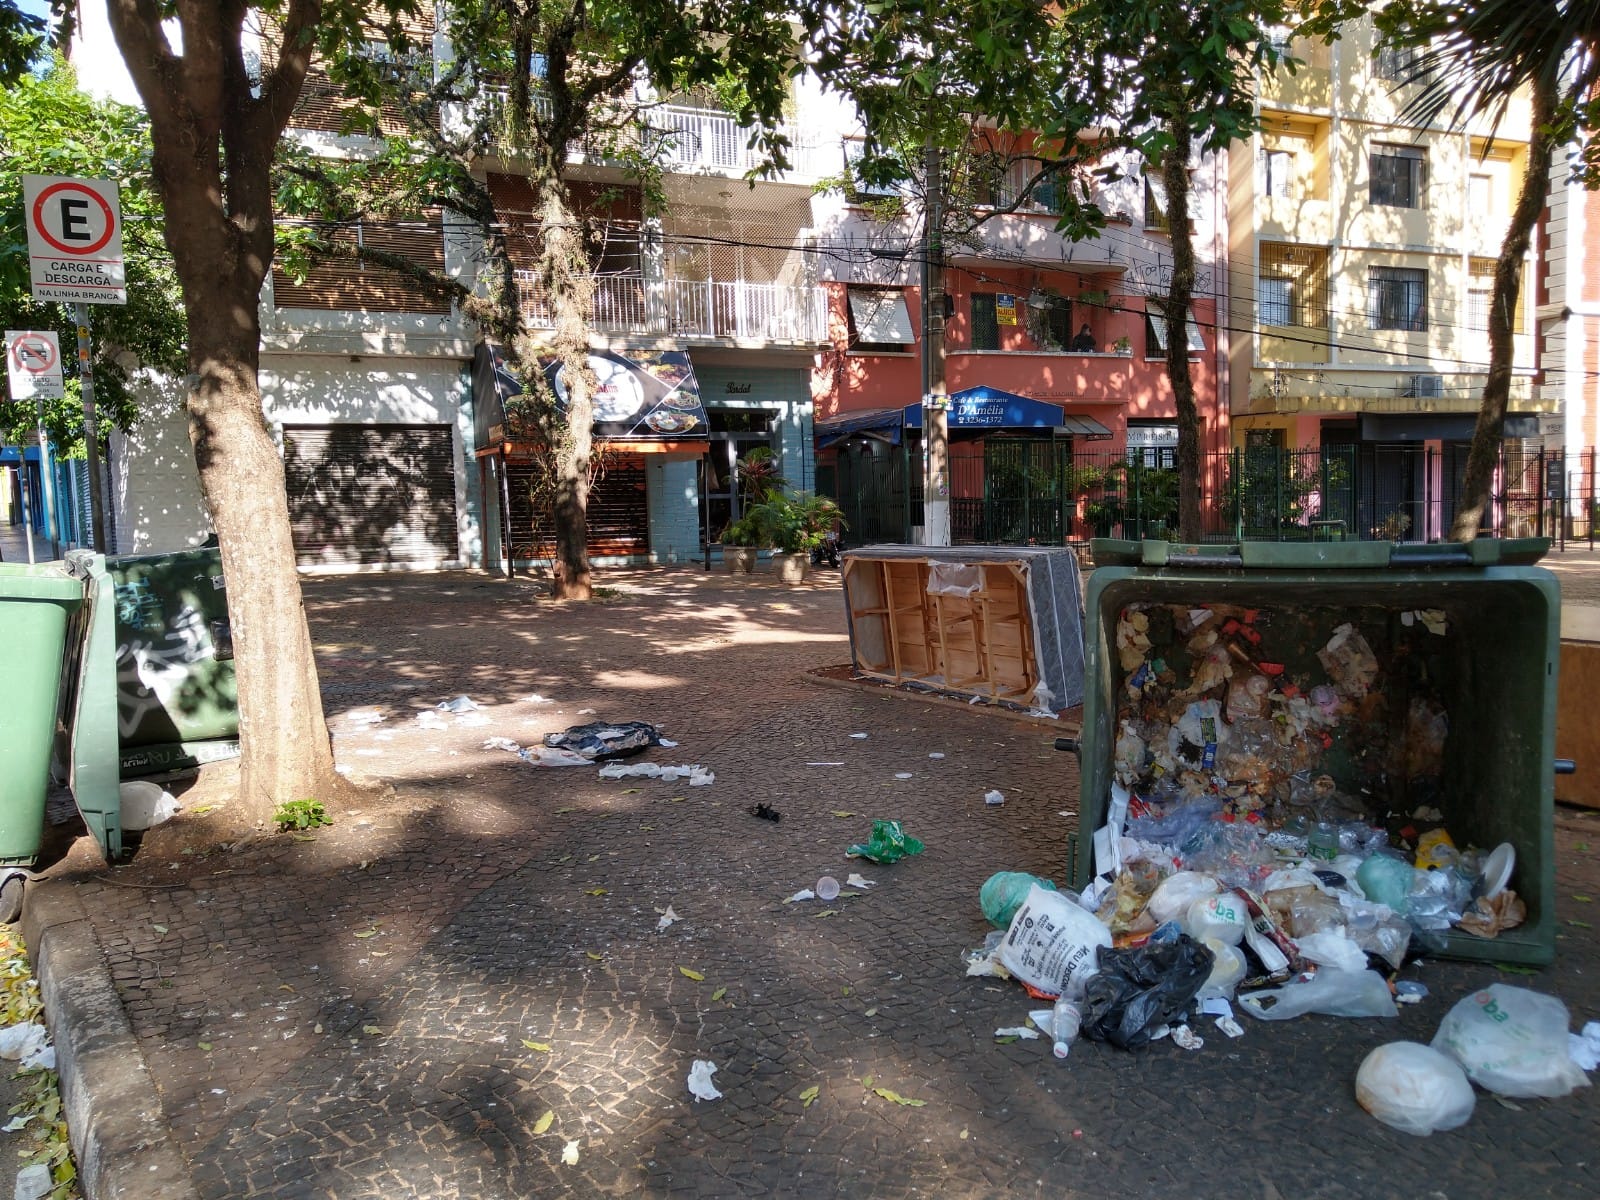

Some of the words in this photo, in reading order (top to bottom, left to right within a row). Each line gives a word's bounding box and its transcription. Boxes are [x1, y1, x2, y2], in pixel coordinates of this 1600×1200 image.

[60, 198, 91, 240] E
[51, 261, 93, 273] CARGA
[96, 264, 104, 273] E
[45, 273, 111, 286] DESCARGA
[39, 289, 52, 297] NA
[53, 290, 80, 298] LINHA
[82, 291, 119, 300] BRANCA
[958, 404, 1004, 416] D'Amélia
[1072, 944, 1091, 963] MEU
